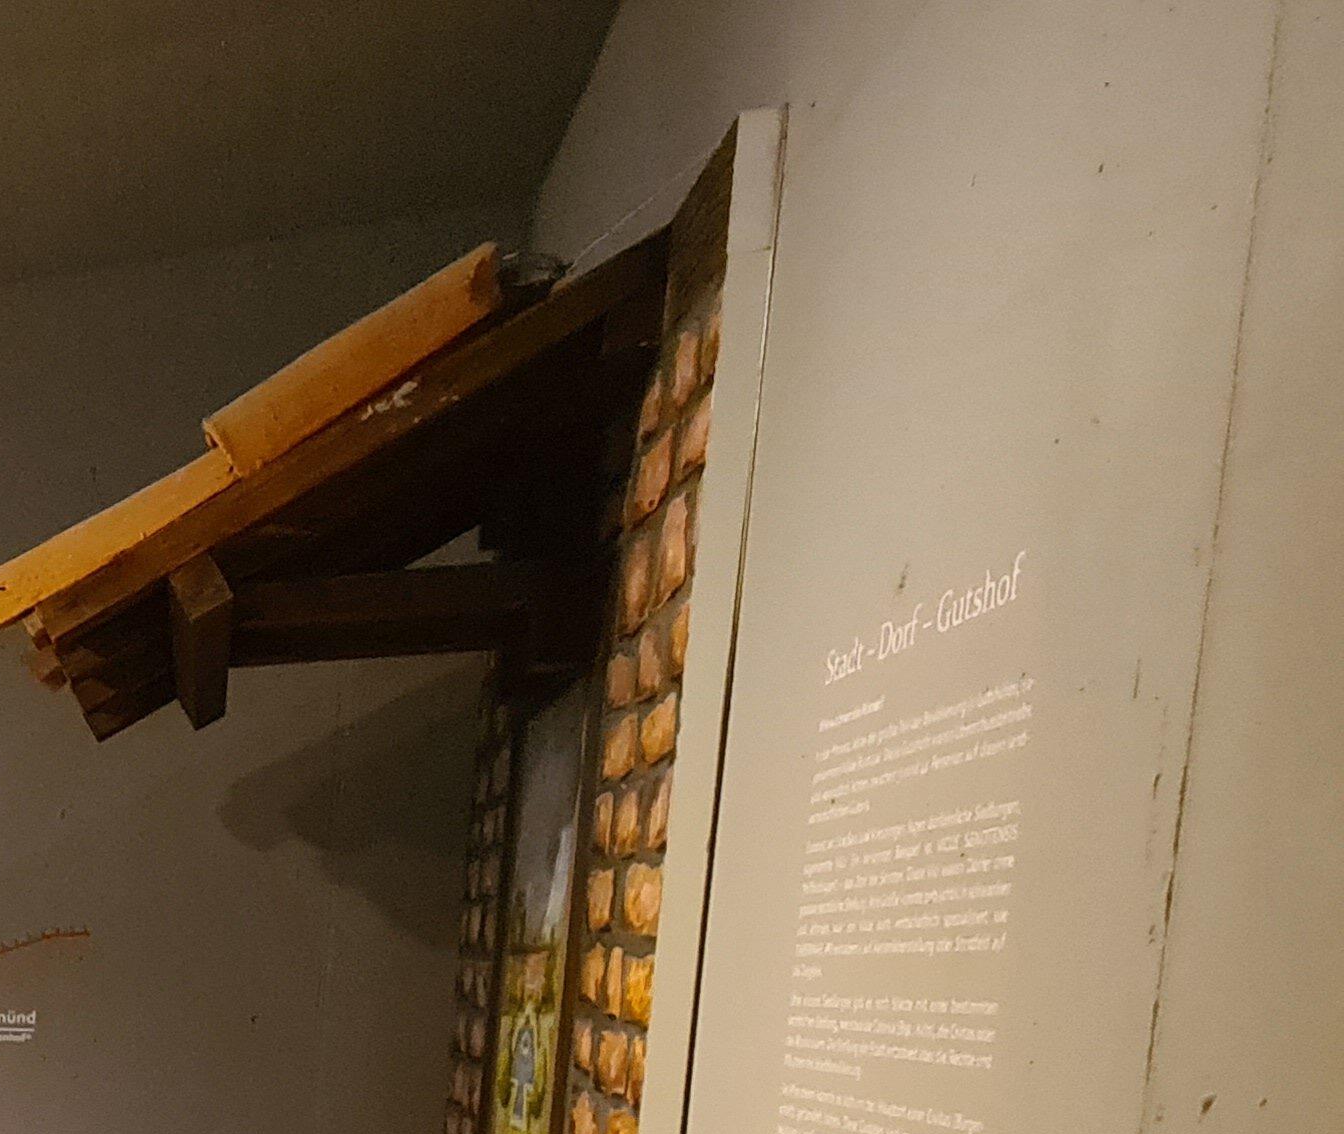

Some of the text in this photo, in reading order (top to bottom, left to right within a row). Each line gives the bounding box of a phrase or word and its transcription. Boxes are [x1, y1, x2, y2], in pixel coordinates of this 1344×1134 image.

[824, 636, 864, 686] Stadt
[878, 602, 922, 661] Dorf
[937, 551, 1026, 633] Gutshof
